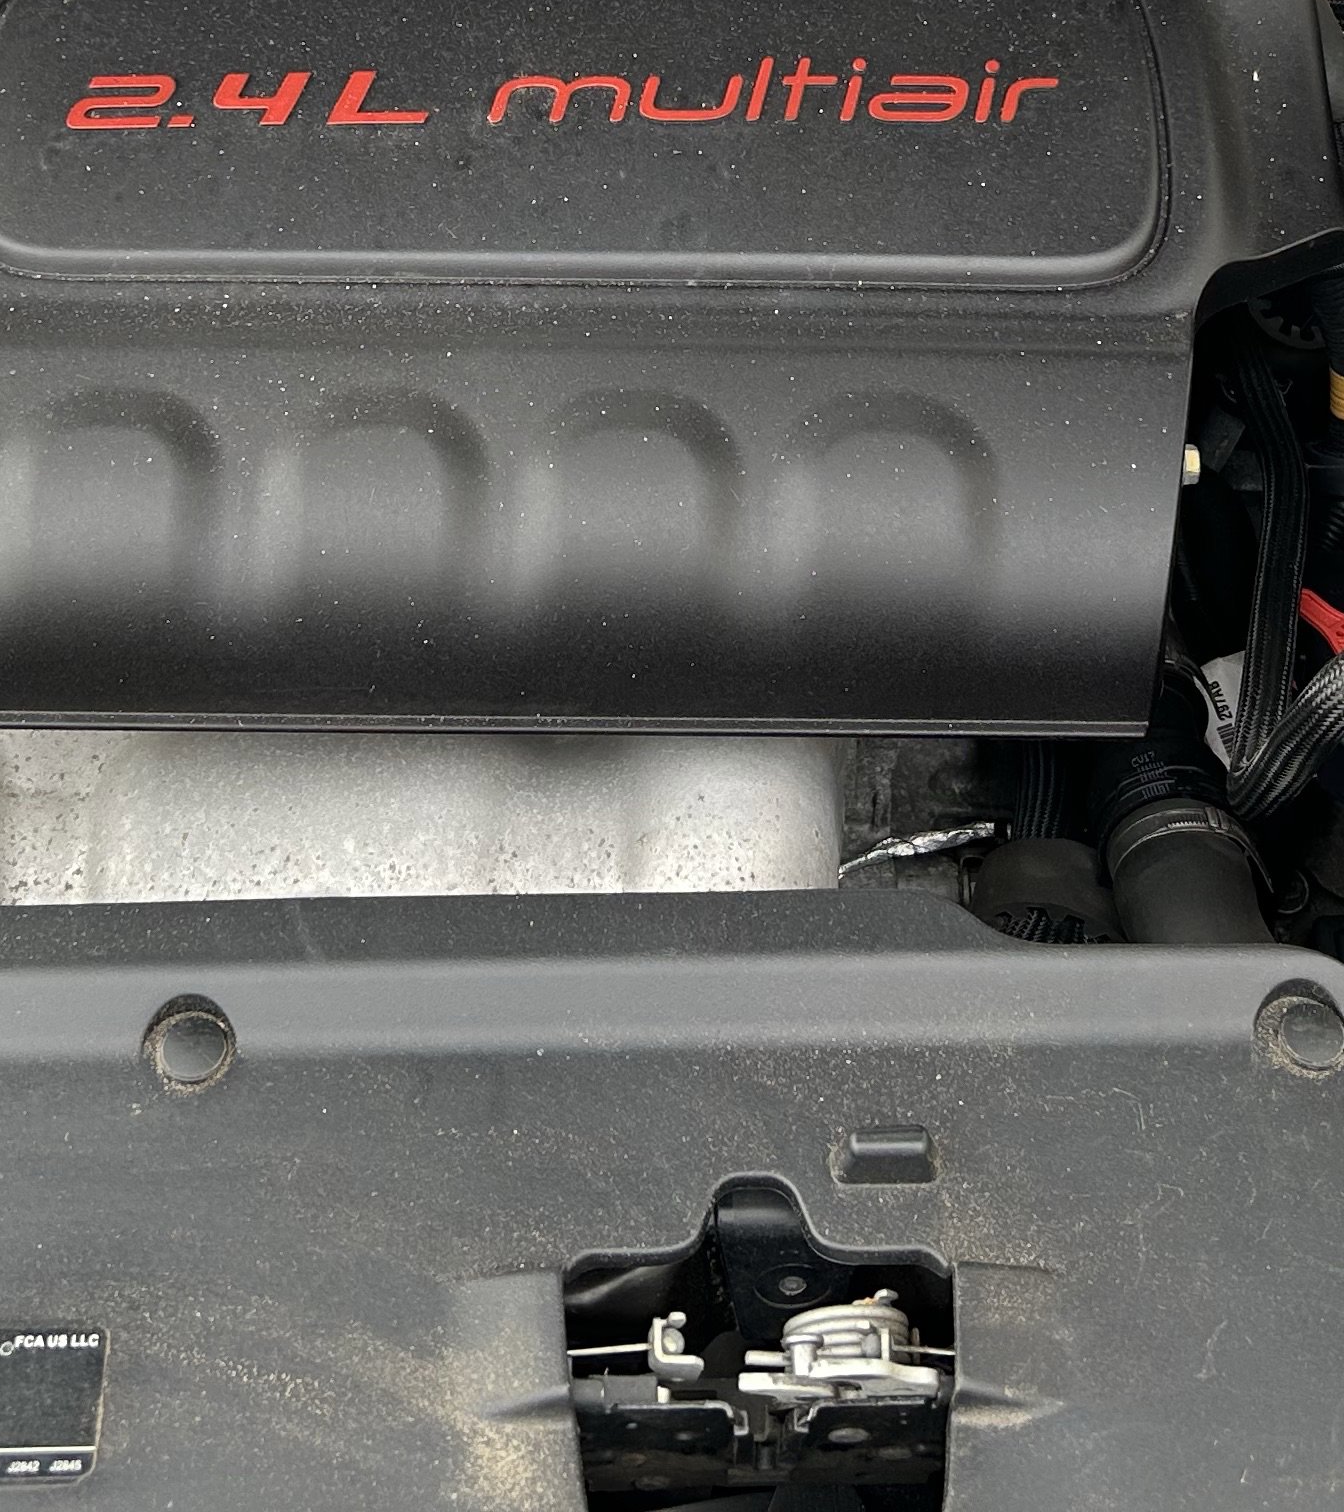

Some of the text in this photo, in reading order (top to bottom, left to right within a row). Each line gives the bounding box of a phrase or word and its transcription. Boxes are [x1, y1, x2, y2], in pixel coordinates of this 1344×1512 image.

[487, 57, 1059, 124] multiair
[14, 1333, 100, 1349] FCA US LLC
